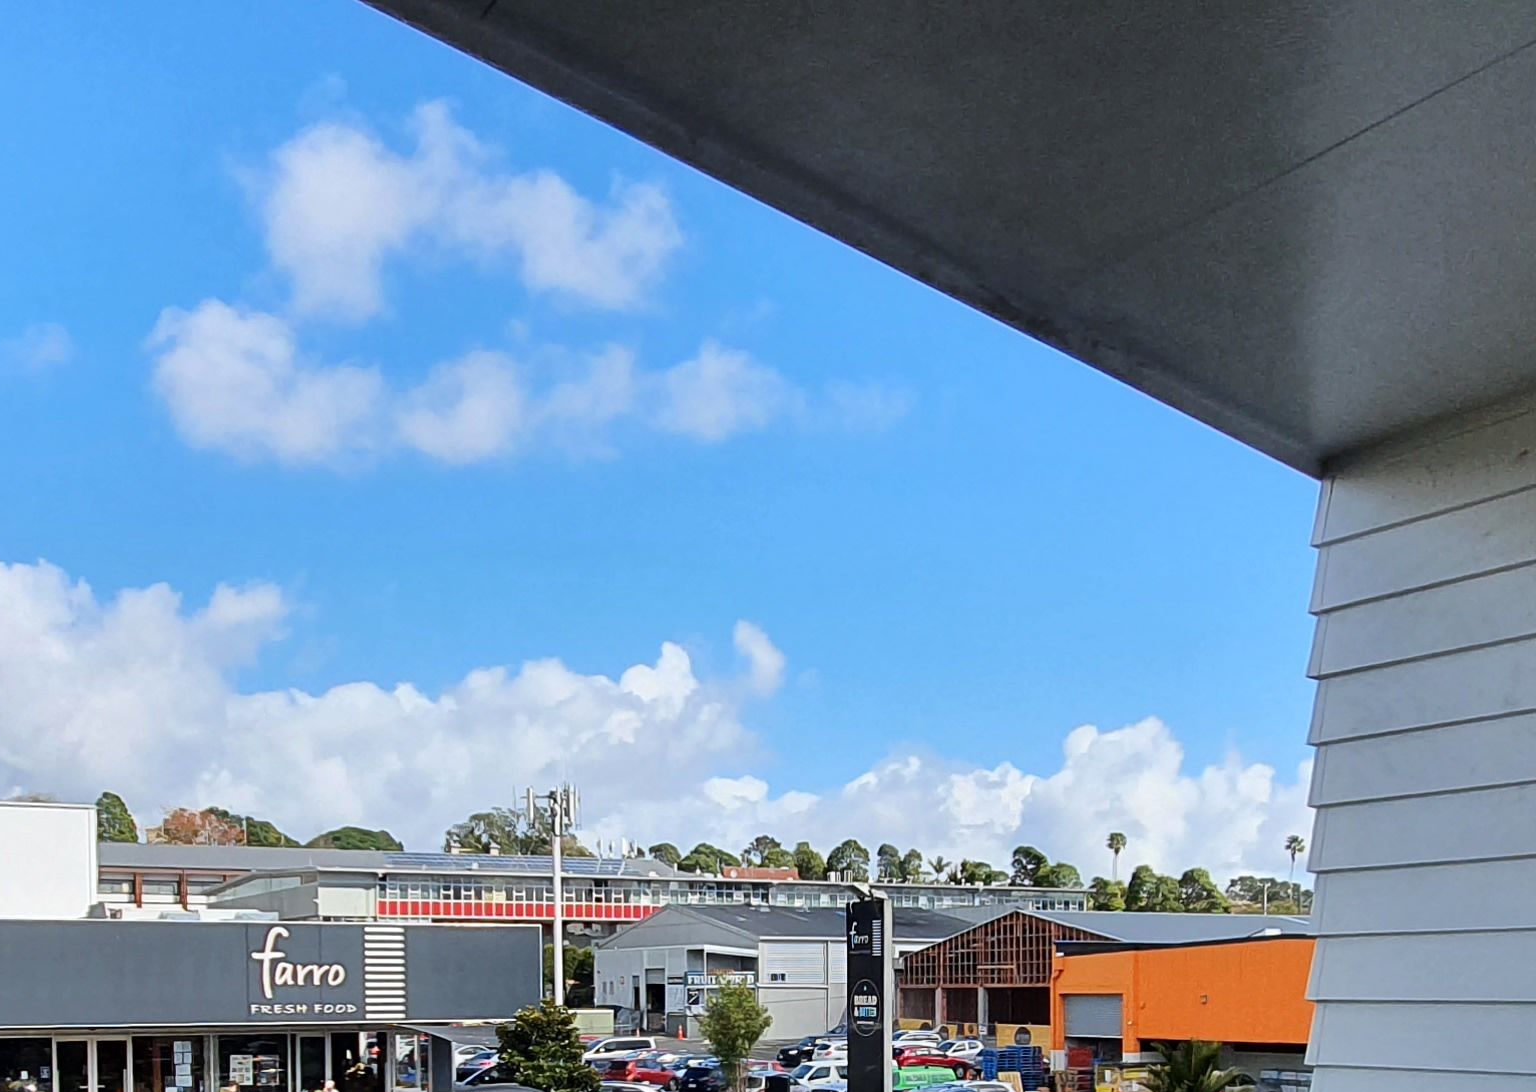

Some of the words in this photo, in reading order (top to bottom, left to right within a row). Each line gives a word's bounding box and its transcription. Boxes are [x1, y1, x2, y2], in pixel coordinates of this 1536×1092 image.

[251, 926, 346, 999] farro
[687, 975, 717, 985] FRUIT
[250, 1004, 308, 1015] FRESH
[314, 1004, 358, 1014] FOOD
